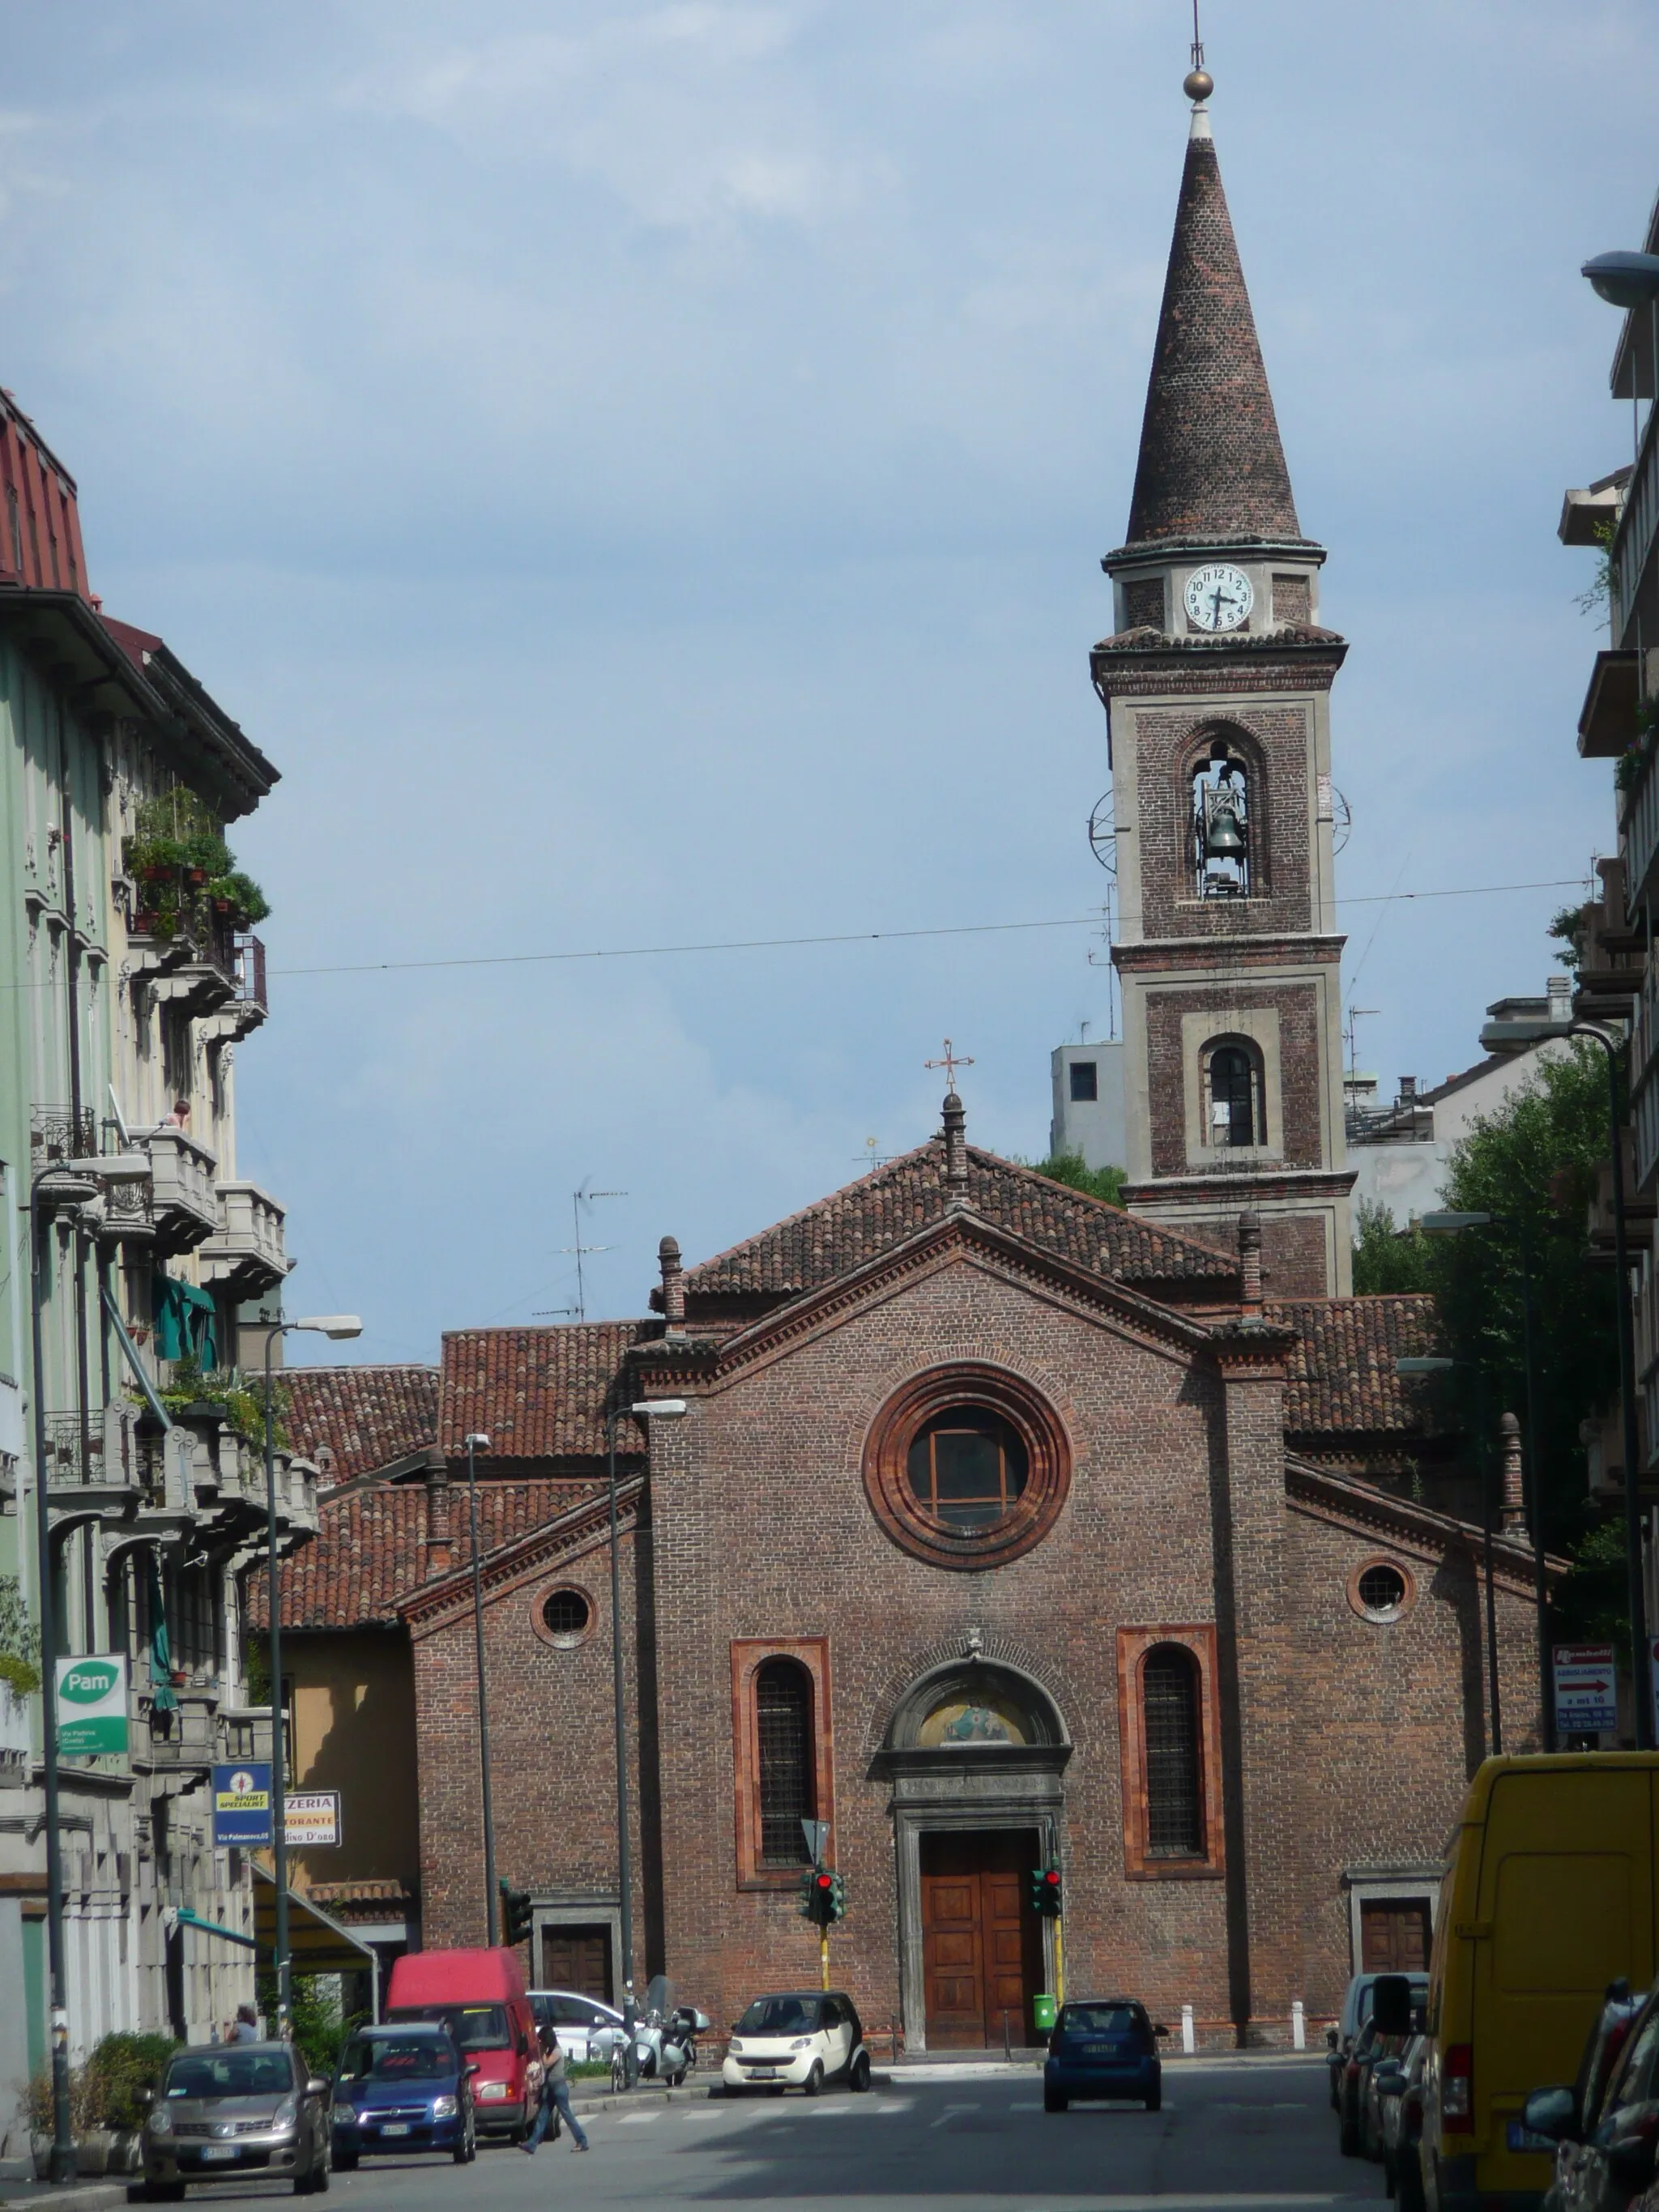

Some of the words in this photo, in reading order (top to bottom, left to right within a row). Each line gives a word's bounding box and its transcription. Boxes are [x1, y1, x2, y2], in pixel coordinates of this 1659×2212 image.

[1204, 573, 1209, 582] 11
[1214, 569, 1224, 579] 12
[1193, 582, 1203, 591] 10
[1235, 580, 1242, 590] 2
[1190, 594, 1196, 603] 9
[1241, 592, 1247, 602] 3
[1194, 606, 1200, 616] 8
[1237, 605, 1243, 615] 4
[1205, 612, 1211, 622] 7
[1217, 616, 1222, 626] 6
[1227, 612, 1234, 622] 5
[69, 1673, 109, 1690] Pam
[217, 1833, 227, 1841] Via
